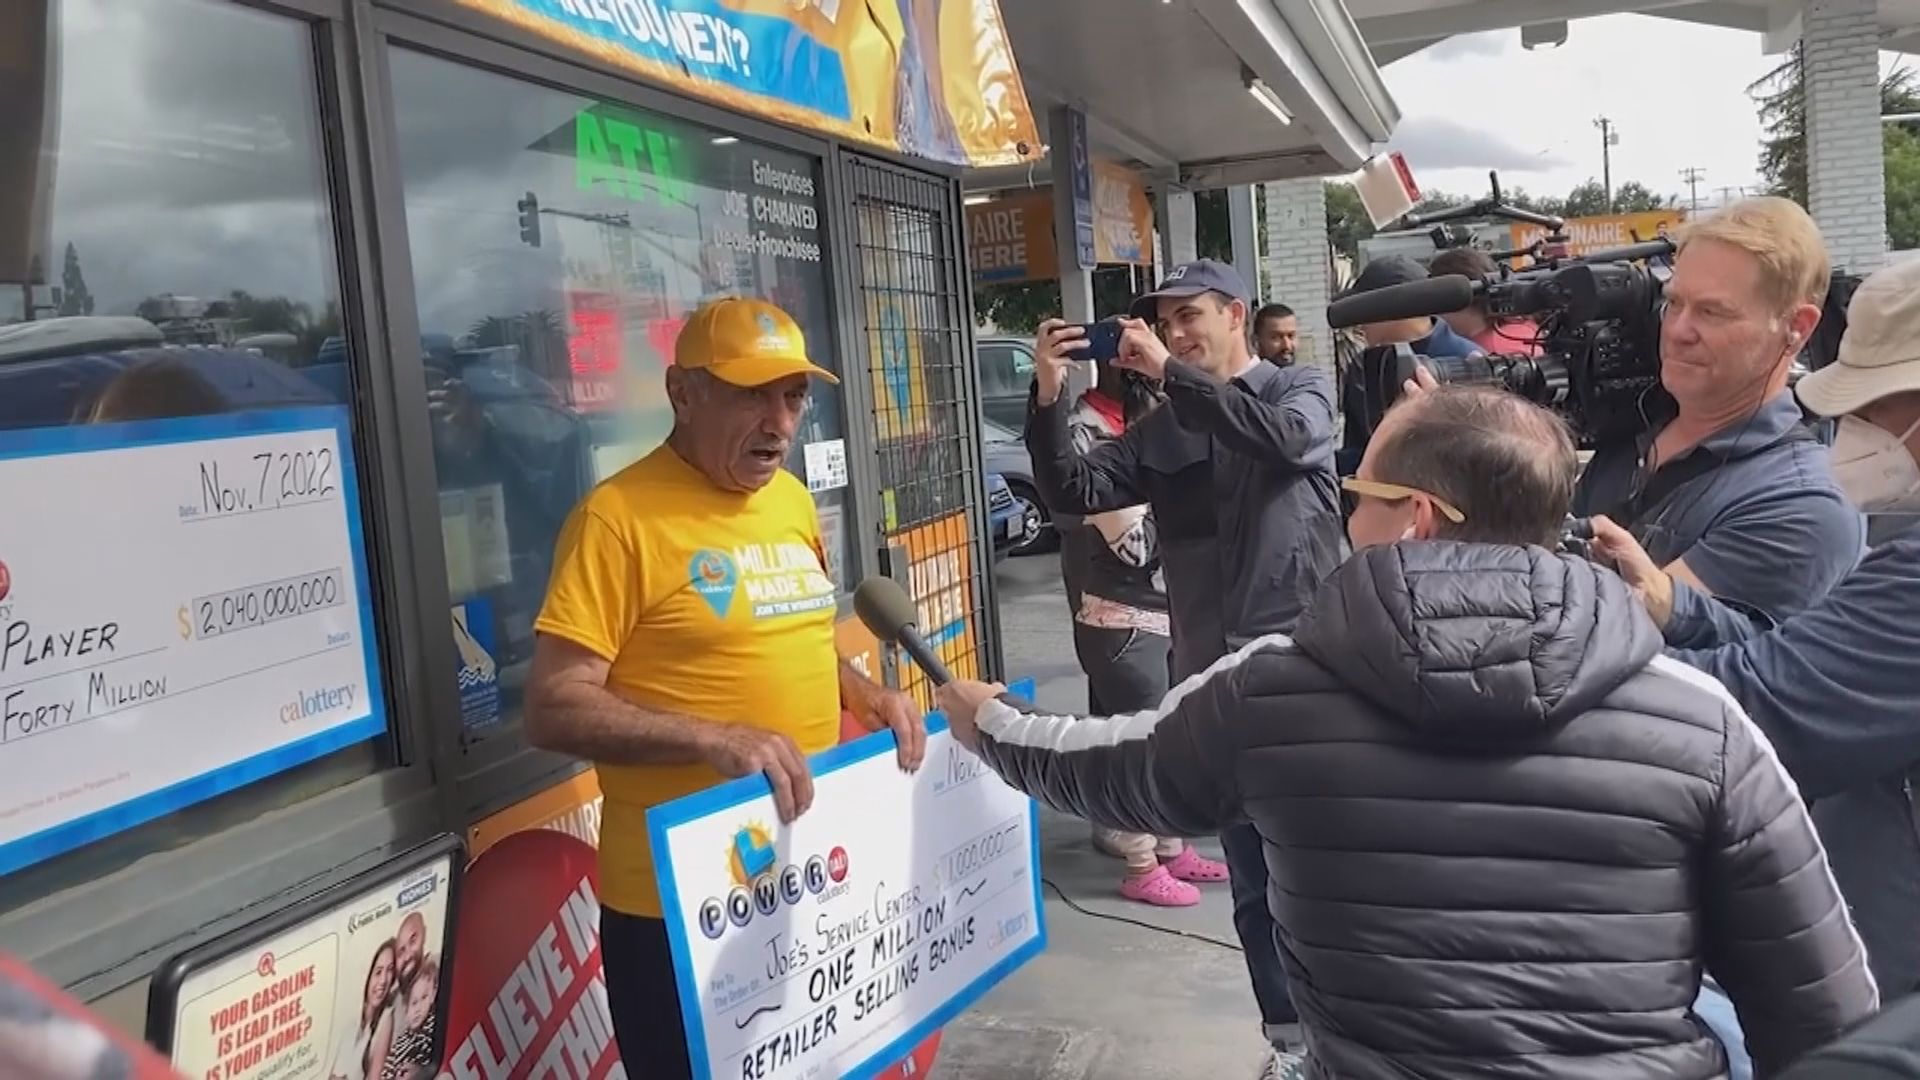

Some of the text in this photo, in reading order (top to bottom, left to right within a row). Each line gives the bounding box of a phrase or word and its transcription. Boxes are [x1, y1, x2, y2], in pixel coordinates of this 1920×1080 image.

[662, 6, 751, 77] NEXT?
[721, 190, 750, 220] JOE
[752, 159, 816, 197] Enterprises
[177, 606, 192, 641] $
[200, 575, 337, 634] 2,040,000,000
[1, 620, 119, 672] PLAYER
[279, 683, 357, 725] calottery
[700, 858, 824, 934] POWER
[808, 895, 947, 1003] ONE MILLION
[209, 963, 316, 1035] YOUR GASOLINE
[217, 995, 306, 1059] IS LEAD FREE.
[742, 1004, 838, 1080] RETAILER
[854, 953, 920, 1021] SELLING
[928, 916, 976, 972] BONUS
[224, 1043, 263, 1080] YOUR
[265, 1015, 313, 1059] HOME?
